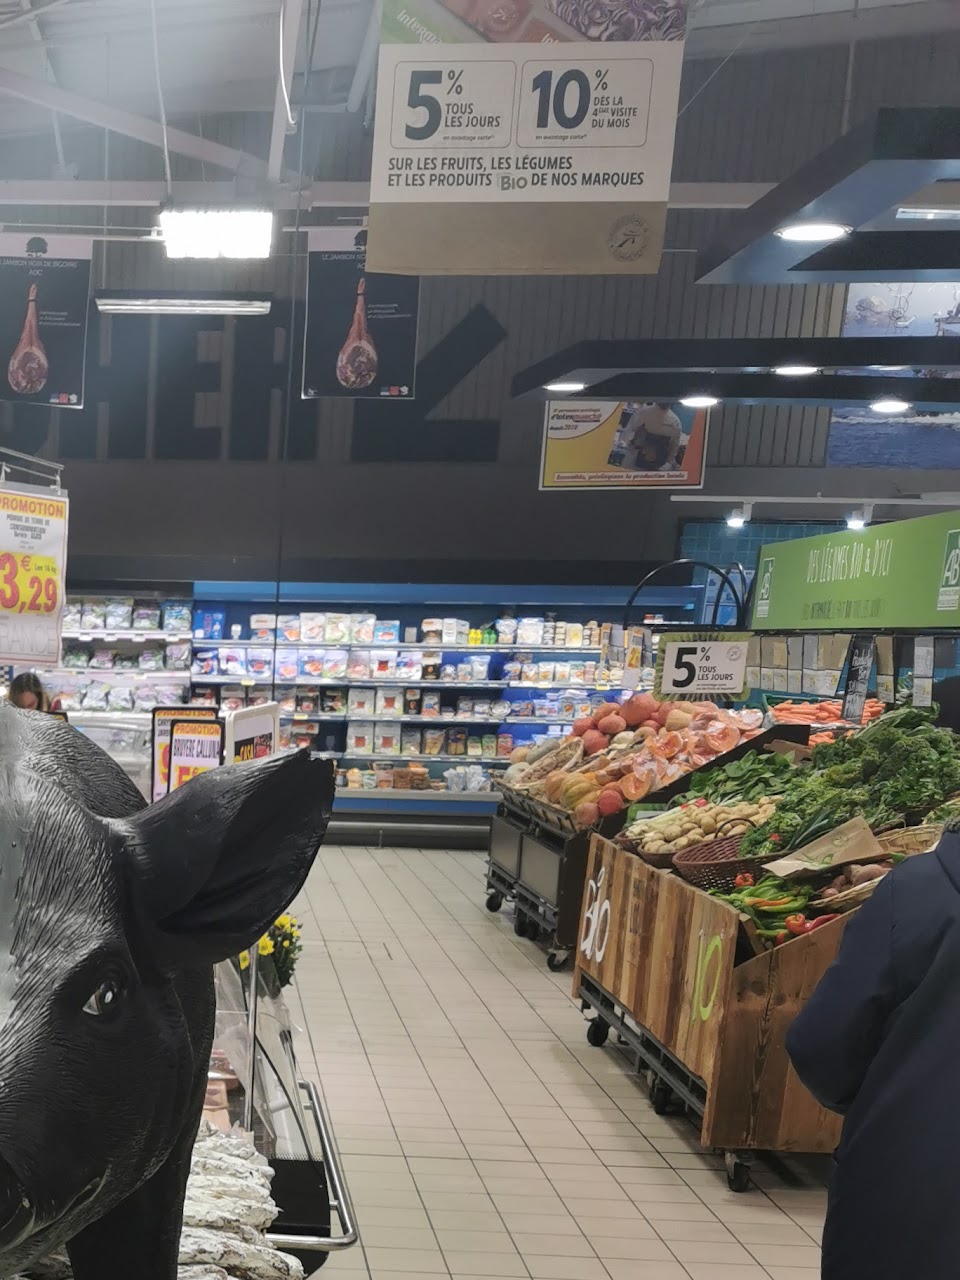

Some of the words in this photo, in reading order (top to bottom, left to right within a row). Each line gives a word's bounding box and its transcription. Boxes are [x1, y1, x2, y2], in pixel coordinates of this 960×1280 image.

[612, 96, 624, 106] LA
[445, 103, 474, 115] TOUS
[611, 107, 638, 117] VISITE
[444, 116, 463, 128] LES
[465, 115, 501, 128] JOURS
[591, 118, 604, 128] DU
[607, 118, 630, 128] MOIS
[388, 157, 414, 171] SUR
[417, 157, 438, 171] LES
[441, 157, 487, 172] FRUITS,
[491, 156, 512, 170] LES
[515, 154, 573, 170] LÉGUMES
[387, 173, 402, 187] ET
[405, 173, 426, 187] LES
[429, 173, 493, 186] PRODUITS
[531, 172, 548, 186] DE
[551, 172, 577, 186] NOS
[581, 171, 645, 187] MARQUES
[806, 549, 820, 583] DES
[864, 548, 871, 573] &
[698, 665, 717, 673] TOUS
[697, 673, 710, 681] LES
[710, 673, 734, 681] JOURS
[175, 724, 220, 735] PROMOTION
